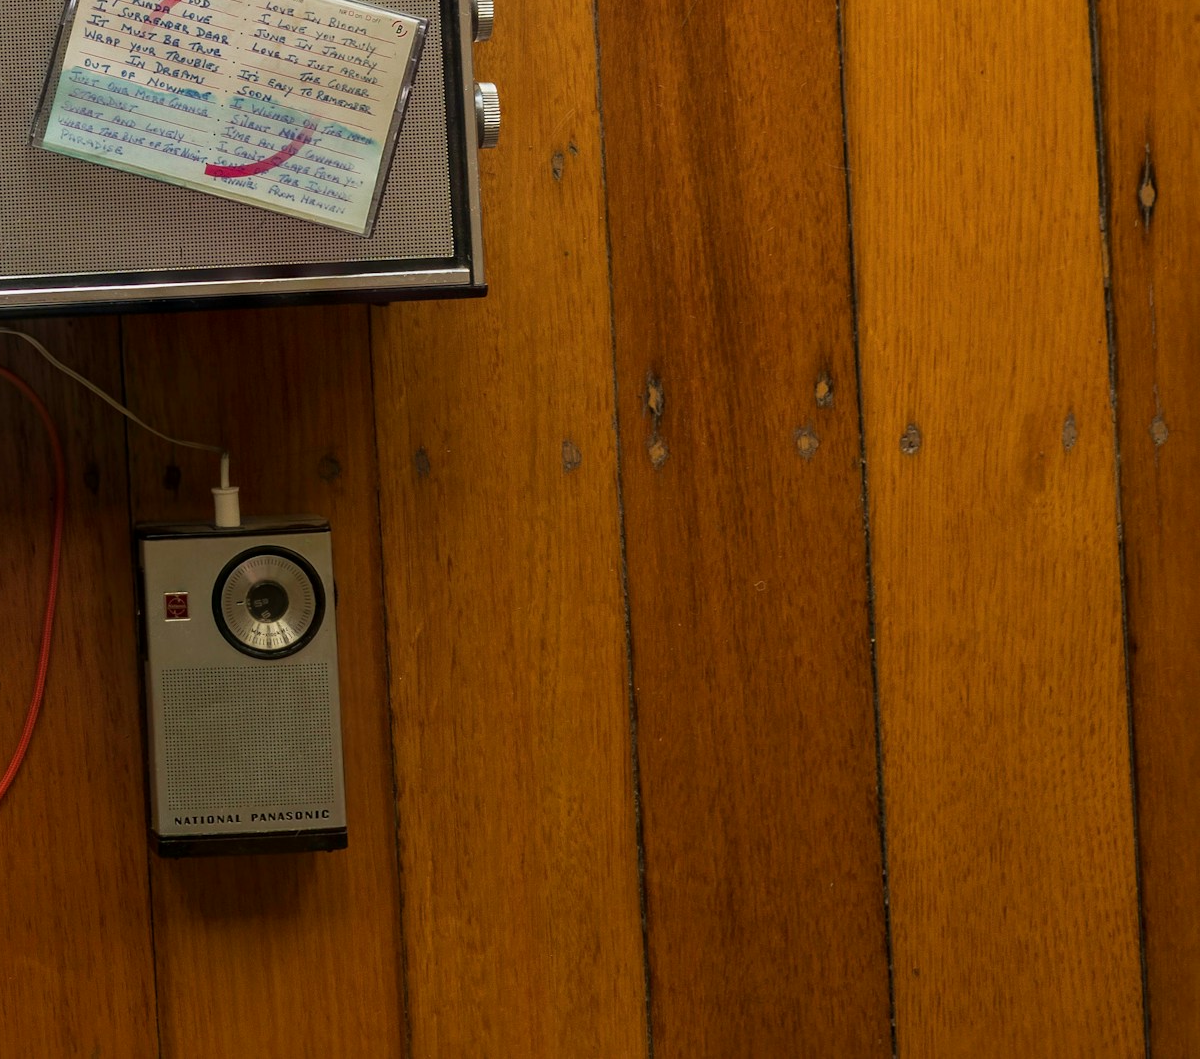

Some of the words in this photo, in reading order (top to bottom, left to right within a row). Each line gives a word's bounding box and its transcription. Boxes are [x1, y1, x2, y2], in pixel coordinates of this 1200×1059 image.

[182, 10, 212, 25] LOVE
[266, 2, 294, 17] LOVE
[93, 0, 108, 12] I
[118, 7, 189, 34] SURRENDER
[196, 27, 228, 44] DEAR
[258, 14, 271, 25] I
[278, 19, 307, 34] LOVE
[85, 28, 120, 47] WRAP
[121, 24, 157, 40] MUST
[163, 35, 179, 47] BE
[252, 43, 280, 59] LOVE
[254, 29, 286, 44] JUNE
[296, 39, 313, 50] IN
[322, 46, 377, 75] JANUARY
[85, 59, 111, 73] OUT
[121, 70, 135, 79] OF
[153, 61, 205, 84] DREAMS
[237, 86, 272, 103] SOON
[328, 79, 369, 97] CORNER
[316, 91, 372, 115] REMEMBER
[175, 814, 241, 825] NATIONAL
[251, 810, 329, 822] PANASONIC
